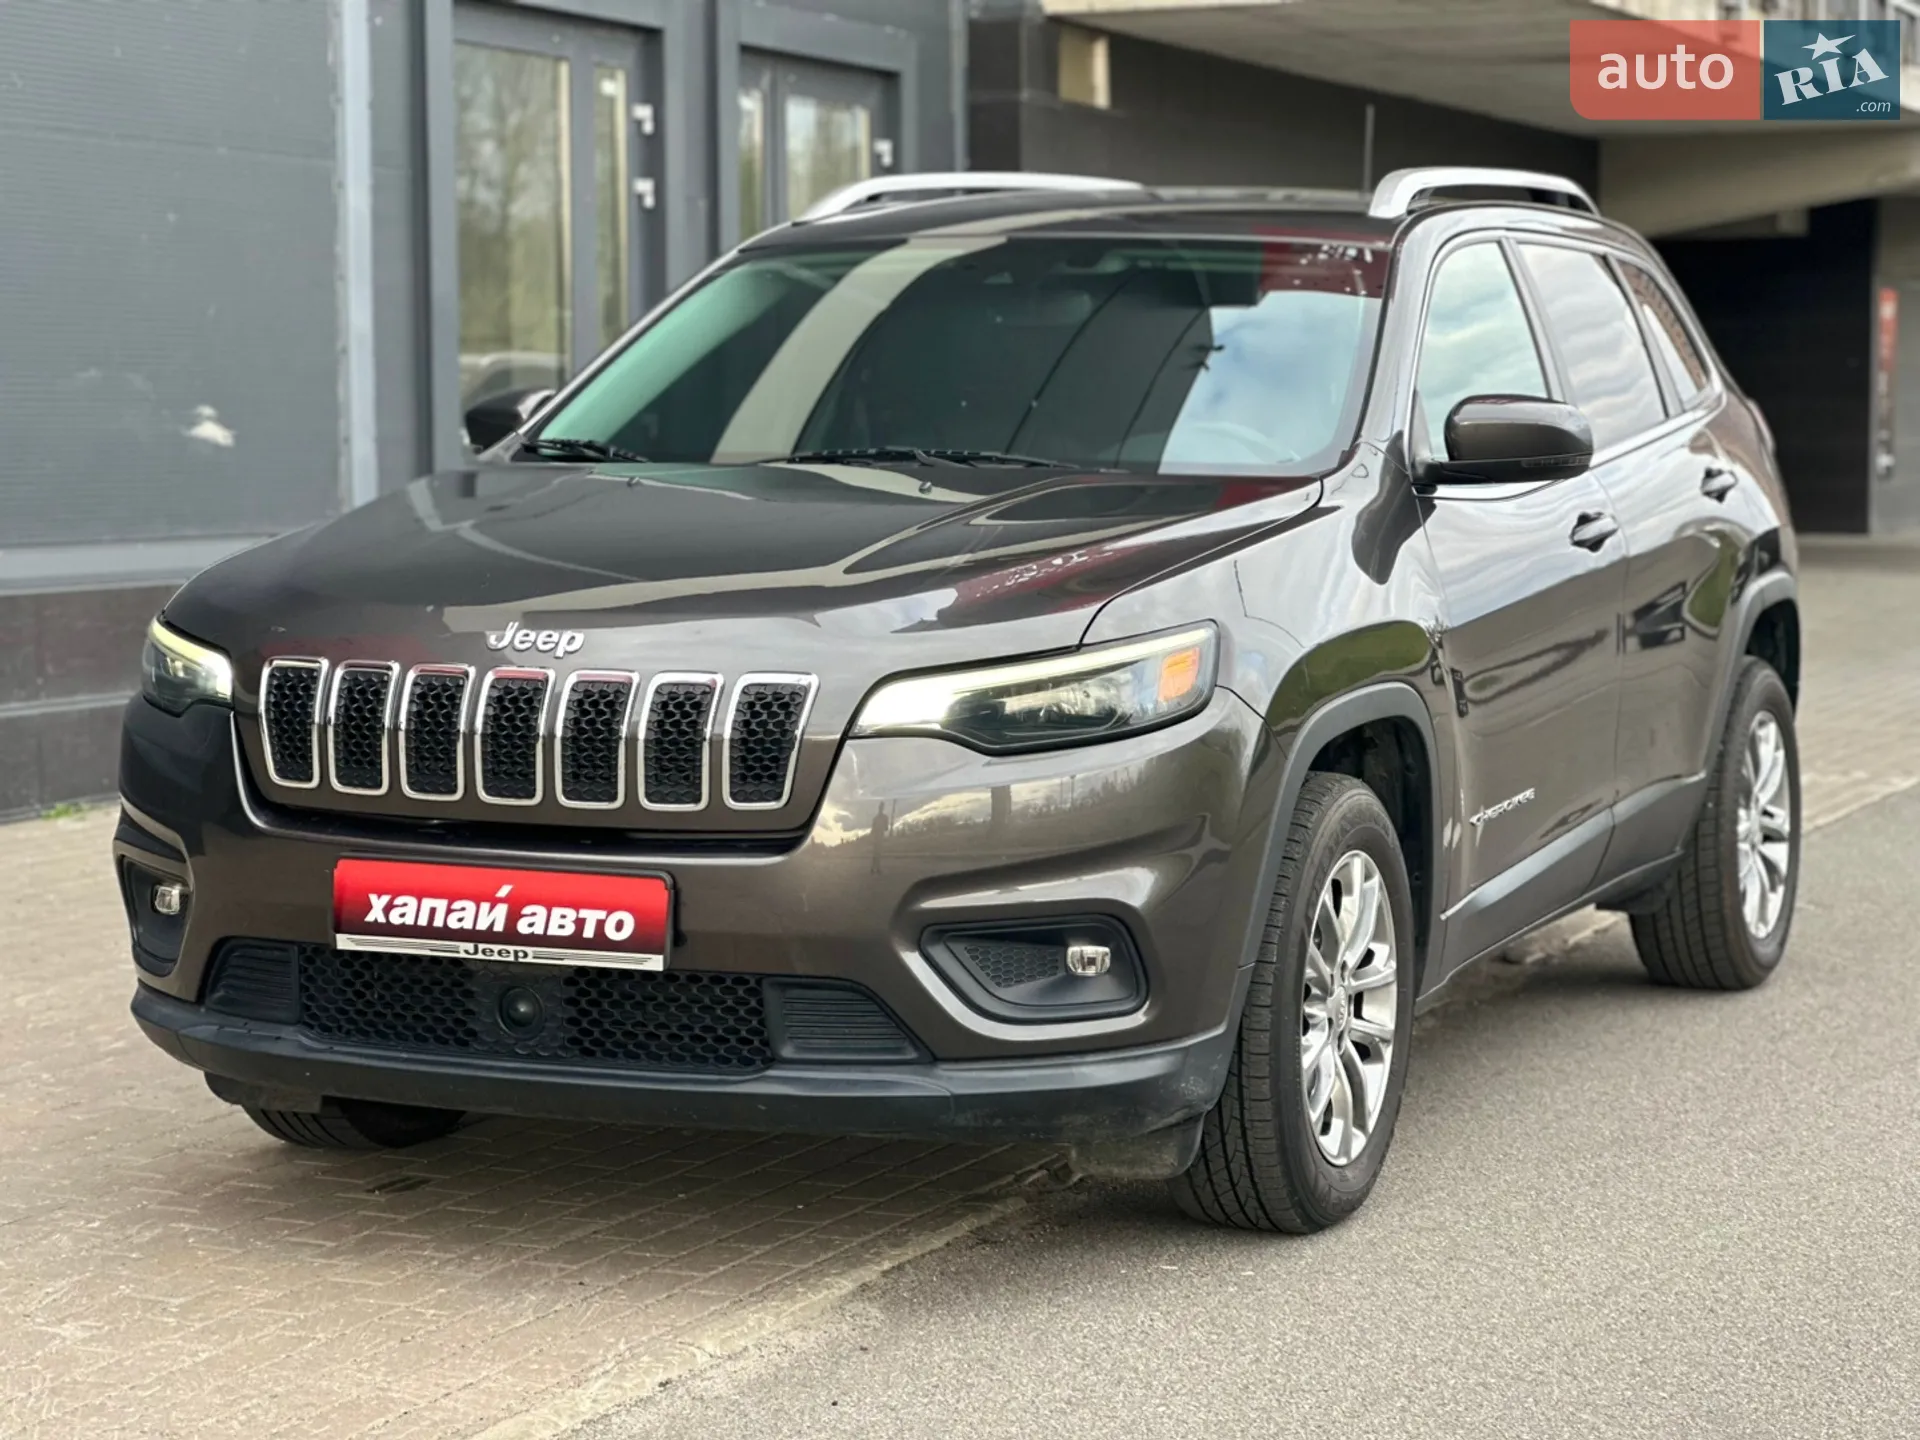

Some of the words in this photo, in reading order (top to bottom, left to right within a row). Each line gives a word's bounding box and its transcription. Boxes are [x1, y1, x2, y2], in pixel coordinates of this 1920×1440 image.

[486, 621, 585, 659] Jeep
[516, 903, 635, 942] авто
[463, 943, 529, 961] Jeep
